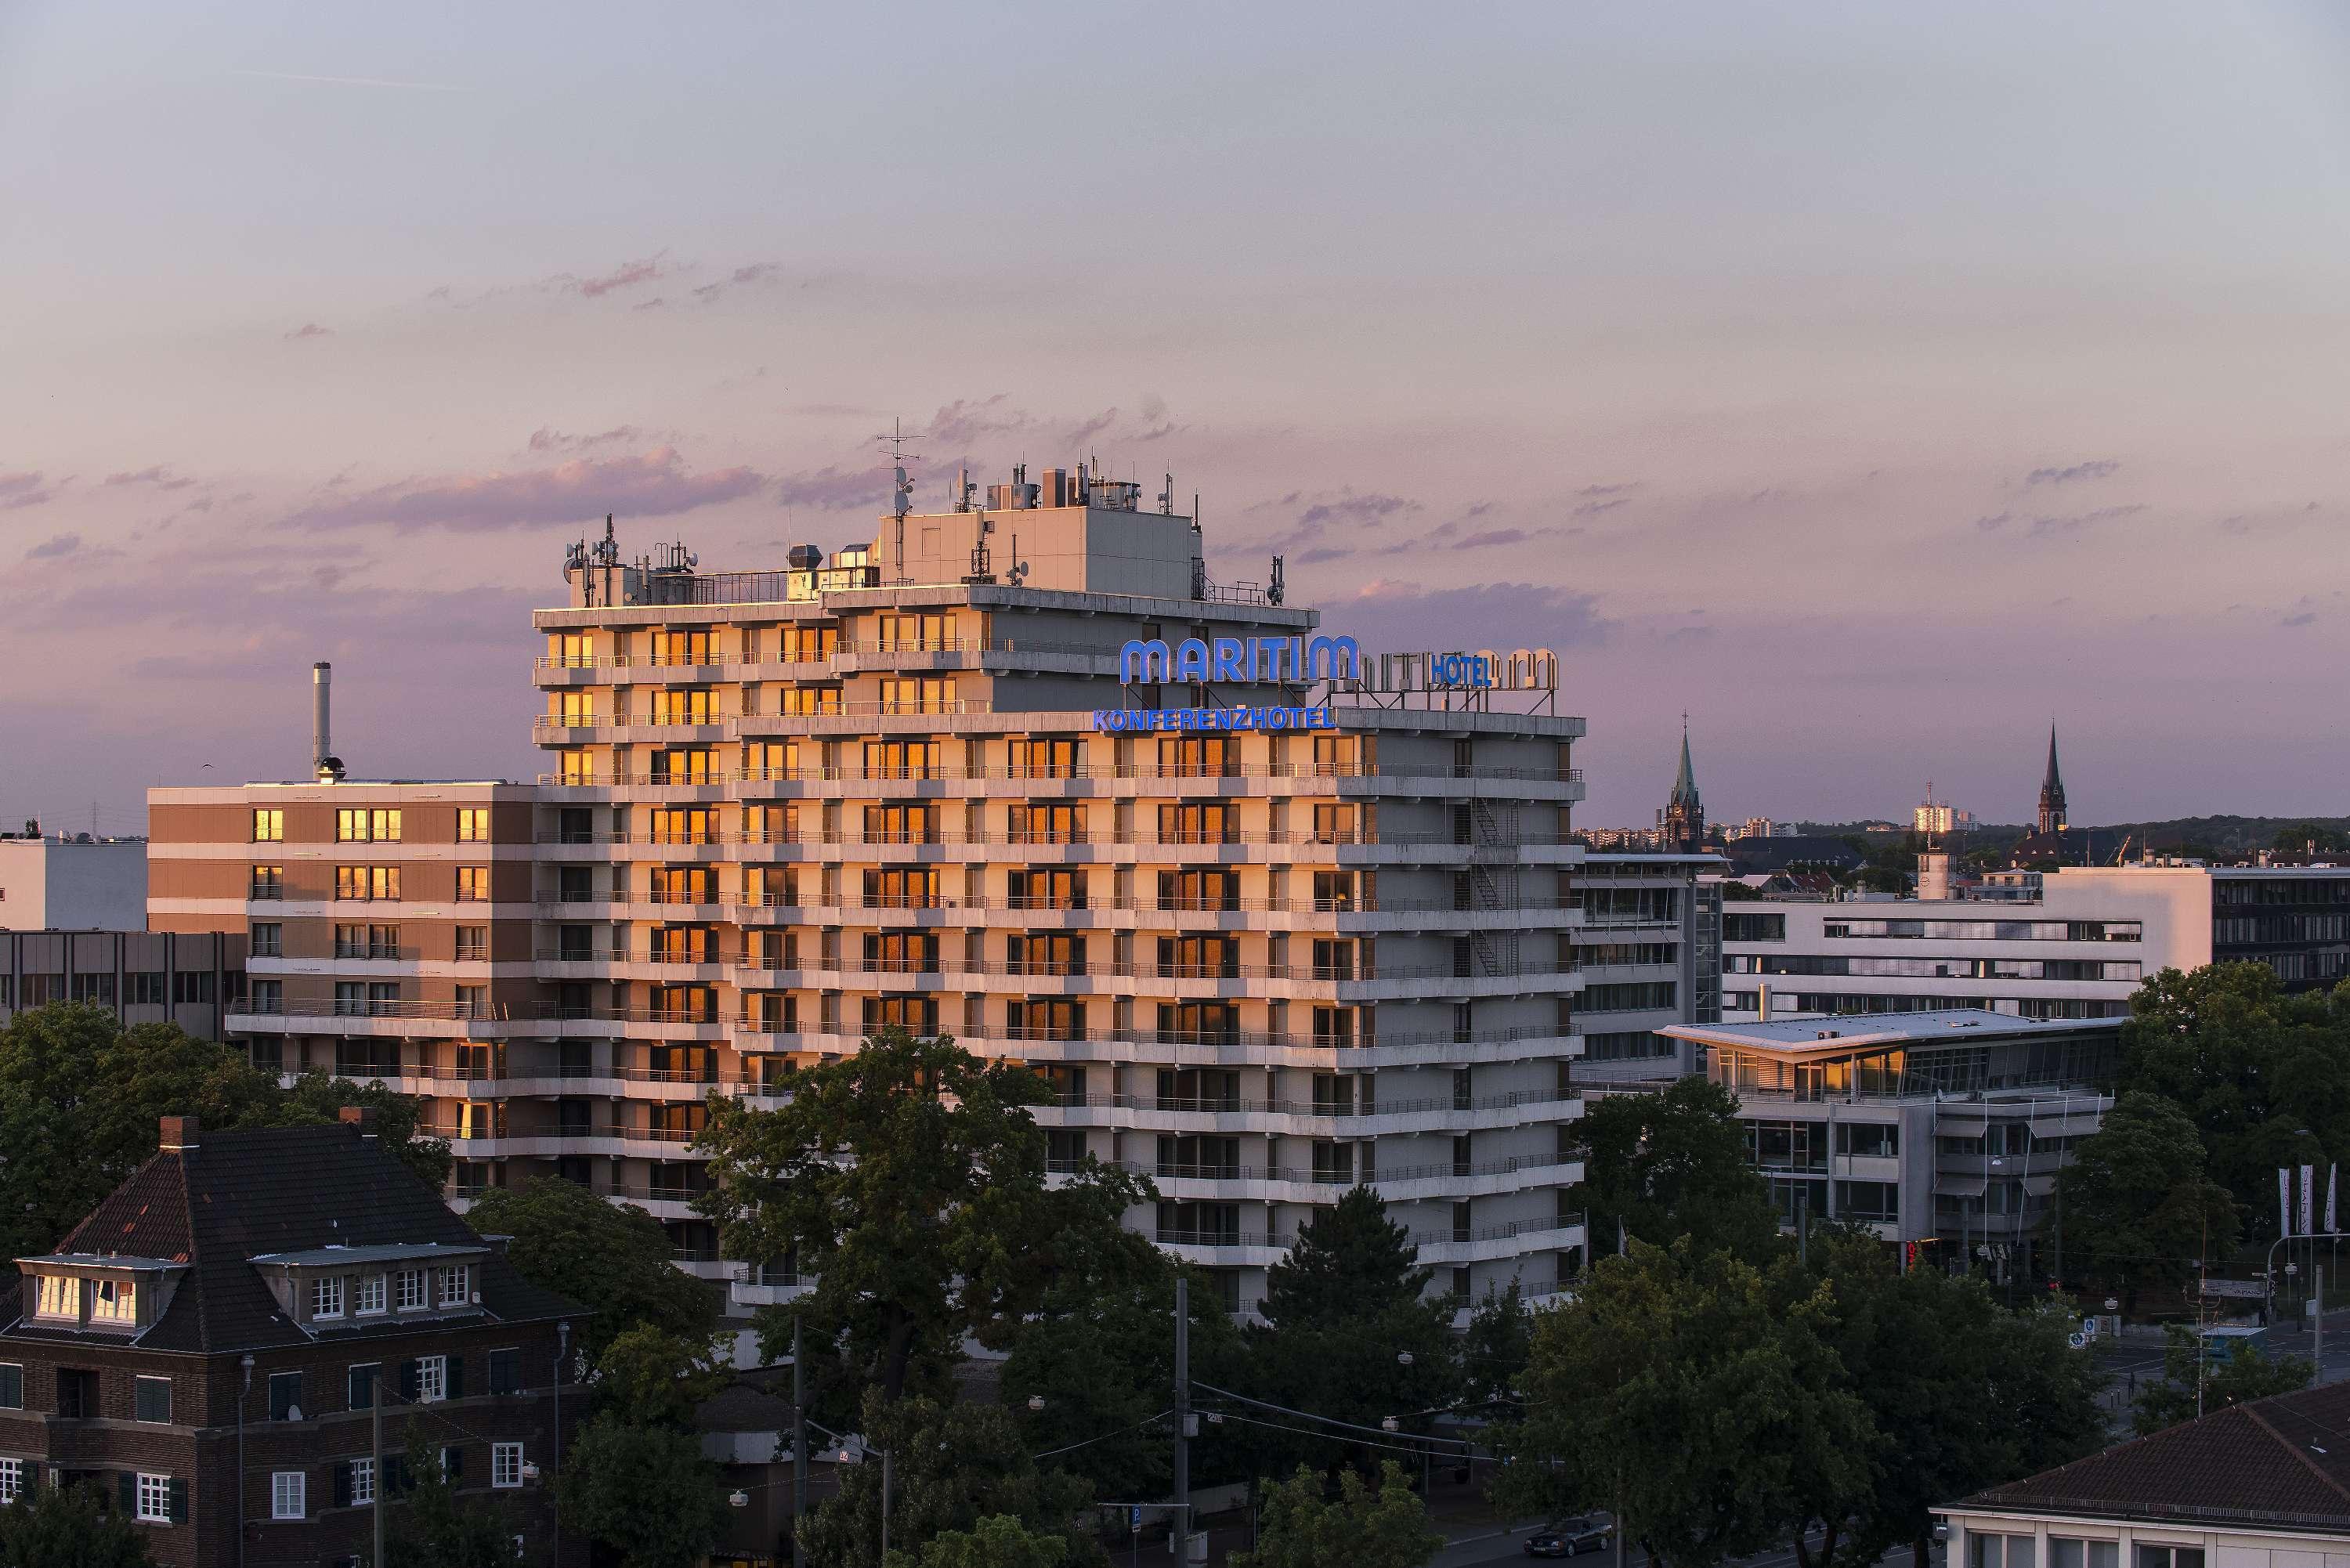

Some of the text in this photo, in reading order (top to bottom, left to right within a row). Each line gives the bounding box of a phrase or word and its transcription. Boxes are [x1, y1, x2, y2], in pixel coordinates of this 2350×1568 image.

[1119, 634, 1360, 684] MARITIM
[1431, 654, 1491, 687] HOTEL
[1093, 707, 1335, 732] KONFERENZHOTEL
